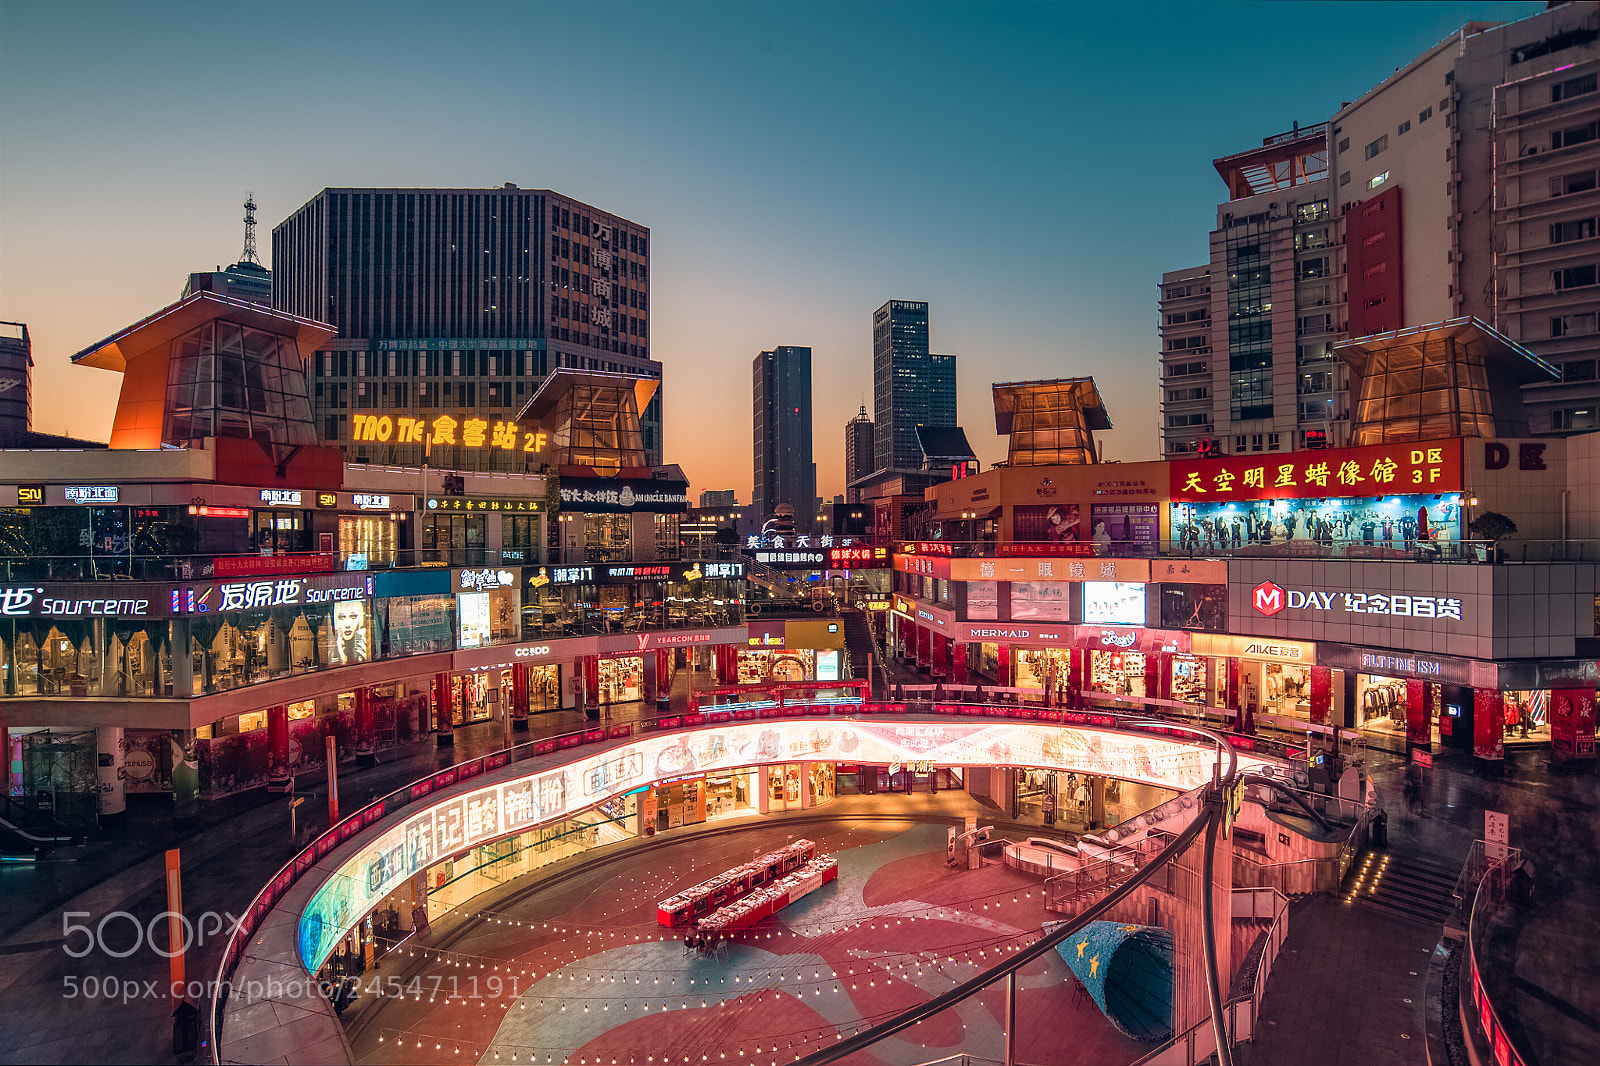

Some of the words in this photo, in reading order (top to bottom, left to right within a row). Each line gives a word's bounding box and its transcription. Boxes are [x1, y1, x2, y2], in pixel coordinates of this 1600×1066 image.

[591, 220, 613, 329] 万博商城
[353, 414, 393, 442] TAO
[432, 415, 518, 450] 食客站
[523, 432, 547, 453] 2F
[1411, 448, 1443, 465] D区
[1181, 457, 1398, 493] 天空明星蜡像馆
[1412, 468, 1441, 484] 3F
[747, 534, 834, 549] 美食天街
[1256, 588, 1281, 610] M
[1345, 592, 1462, 621] 纪念日百货
[656, 635, 693, 644] YEARCON
[970, 629, 1031, 638] MERMAID
[591, 758, 639, 790] 由此进入
[407, 778, 566, 870] 陈记酸辣粉
